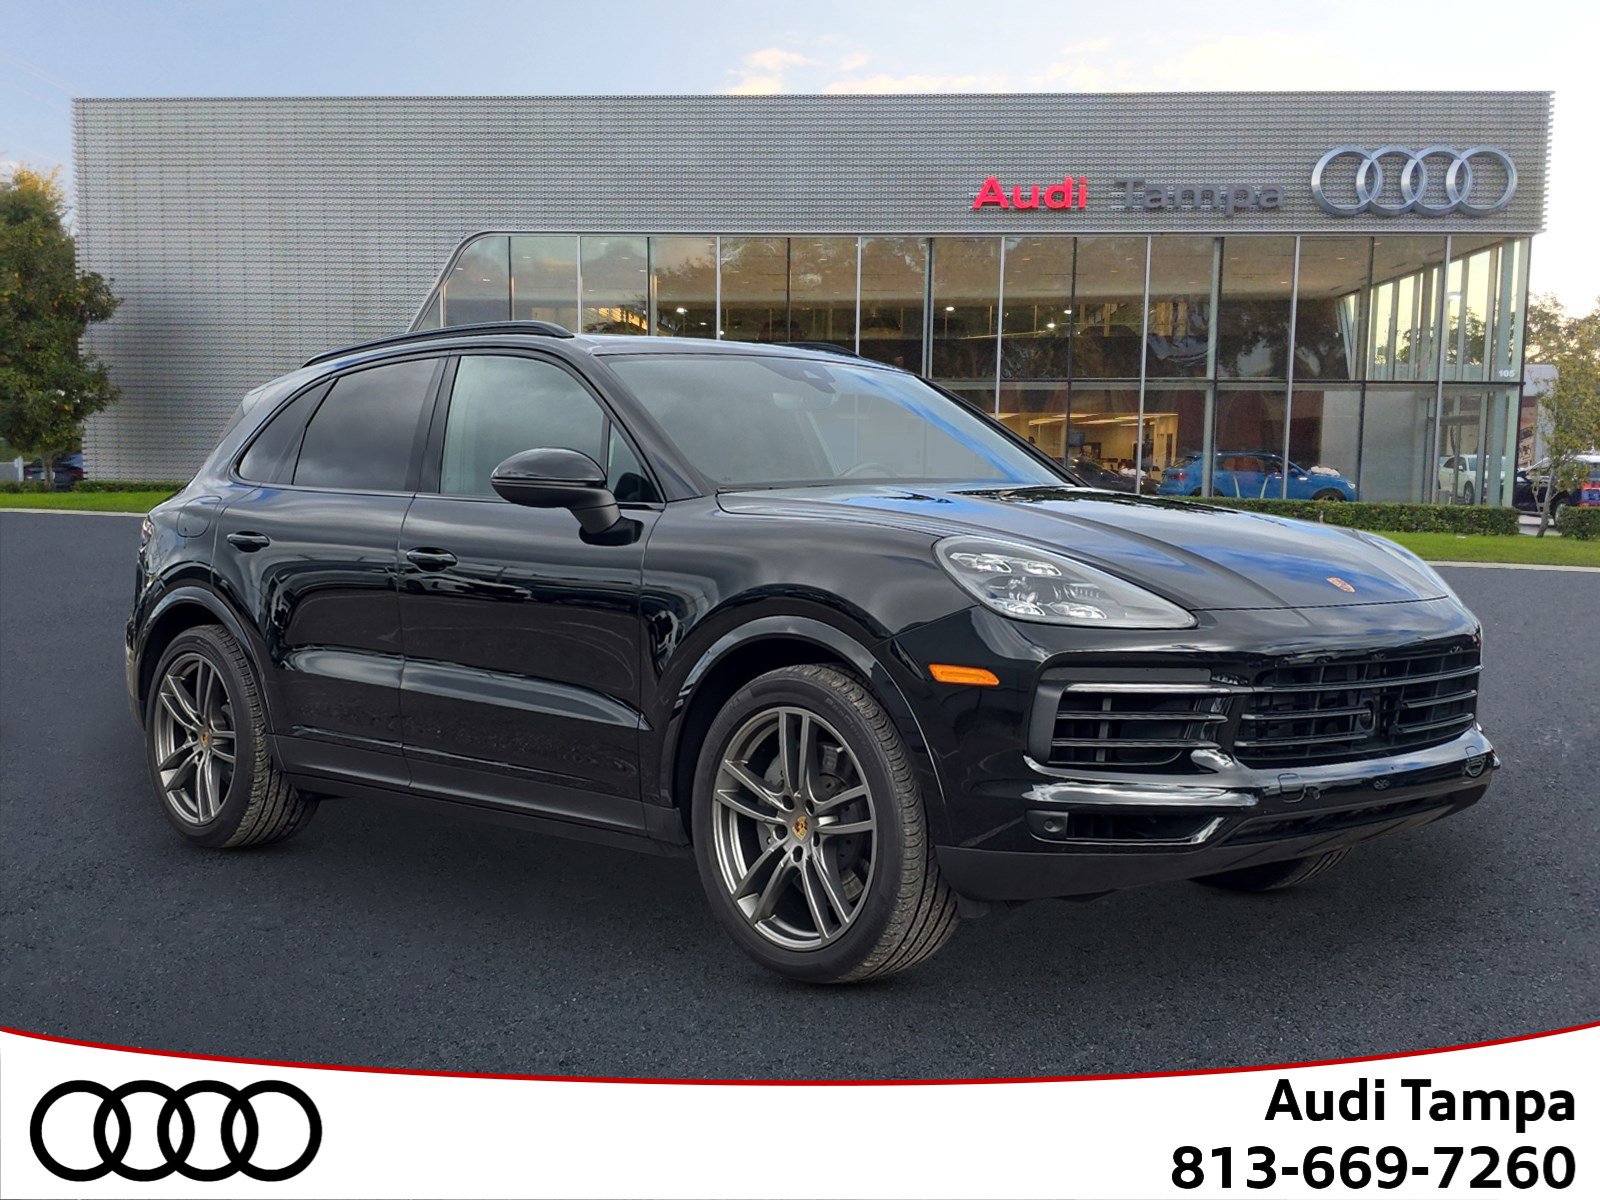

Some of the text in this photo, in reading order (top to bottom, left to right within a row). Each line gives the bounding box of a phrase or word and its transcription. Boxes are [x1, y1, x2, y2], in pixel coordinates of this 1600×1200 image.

[972, 176, 1285, 218] Audi Tampa
[1499, 369, 1515, 378] 105
